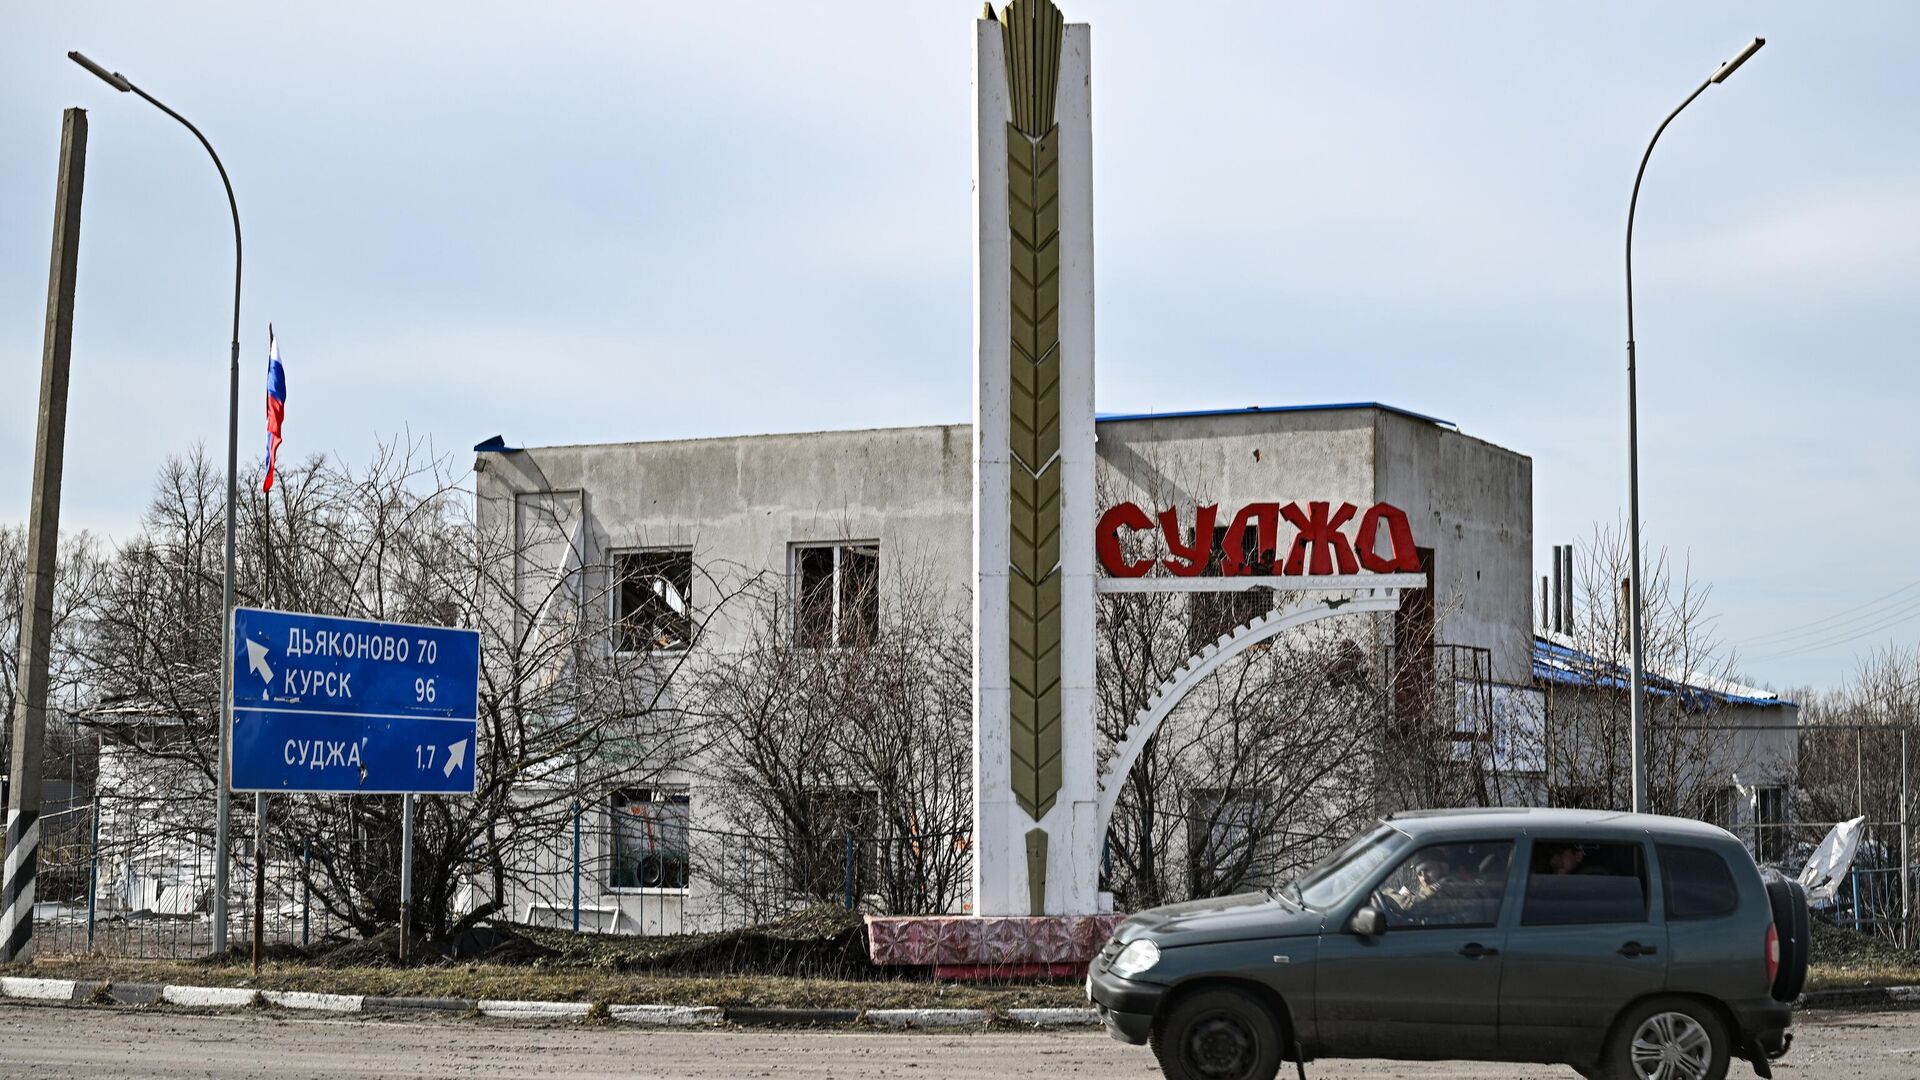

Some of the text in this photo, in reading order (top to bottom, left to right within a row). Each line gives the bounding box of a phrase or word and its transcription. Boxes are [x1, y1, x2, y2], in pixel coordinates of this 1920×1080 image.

[1096, 501, 1420, 577] СУДЖА
[286, 628, 438, 664] ДЬЯКОНОВО 70
[284, 669, 437, 703] КУРСК 96
[284, 739, 436, 770] СУДЖА 1,7
